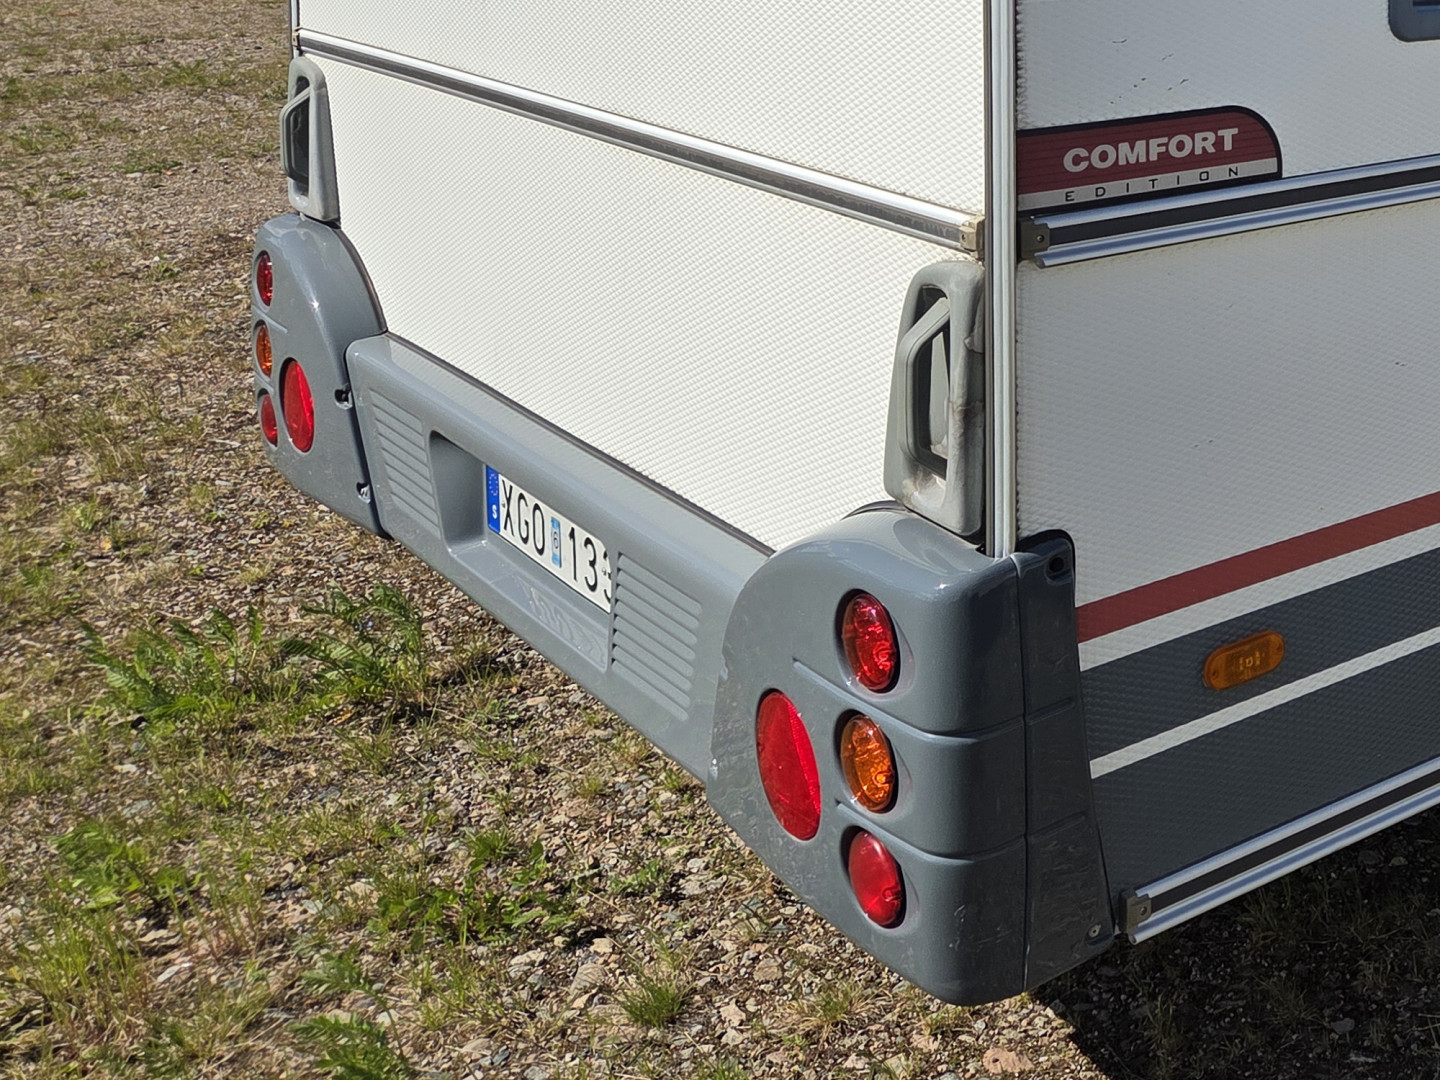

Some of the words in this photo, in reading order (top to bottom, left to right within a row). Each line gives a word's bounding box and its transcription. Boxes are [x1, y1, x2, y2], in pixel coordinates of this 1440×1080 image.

[1062, 127, 1239, 173] COMFORT
[1065, 167, 1238, 201] EDITION
[491, 504, 498, 520] S
[502, 480, 545, 555] XGO
